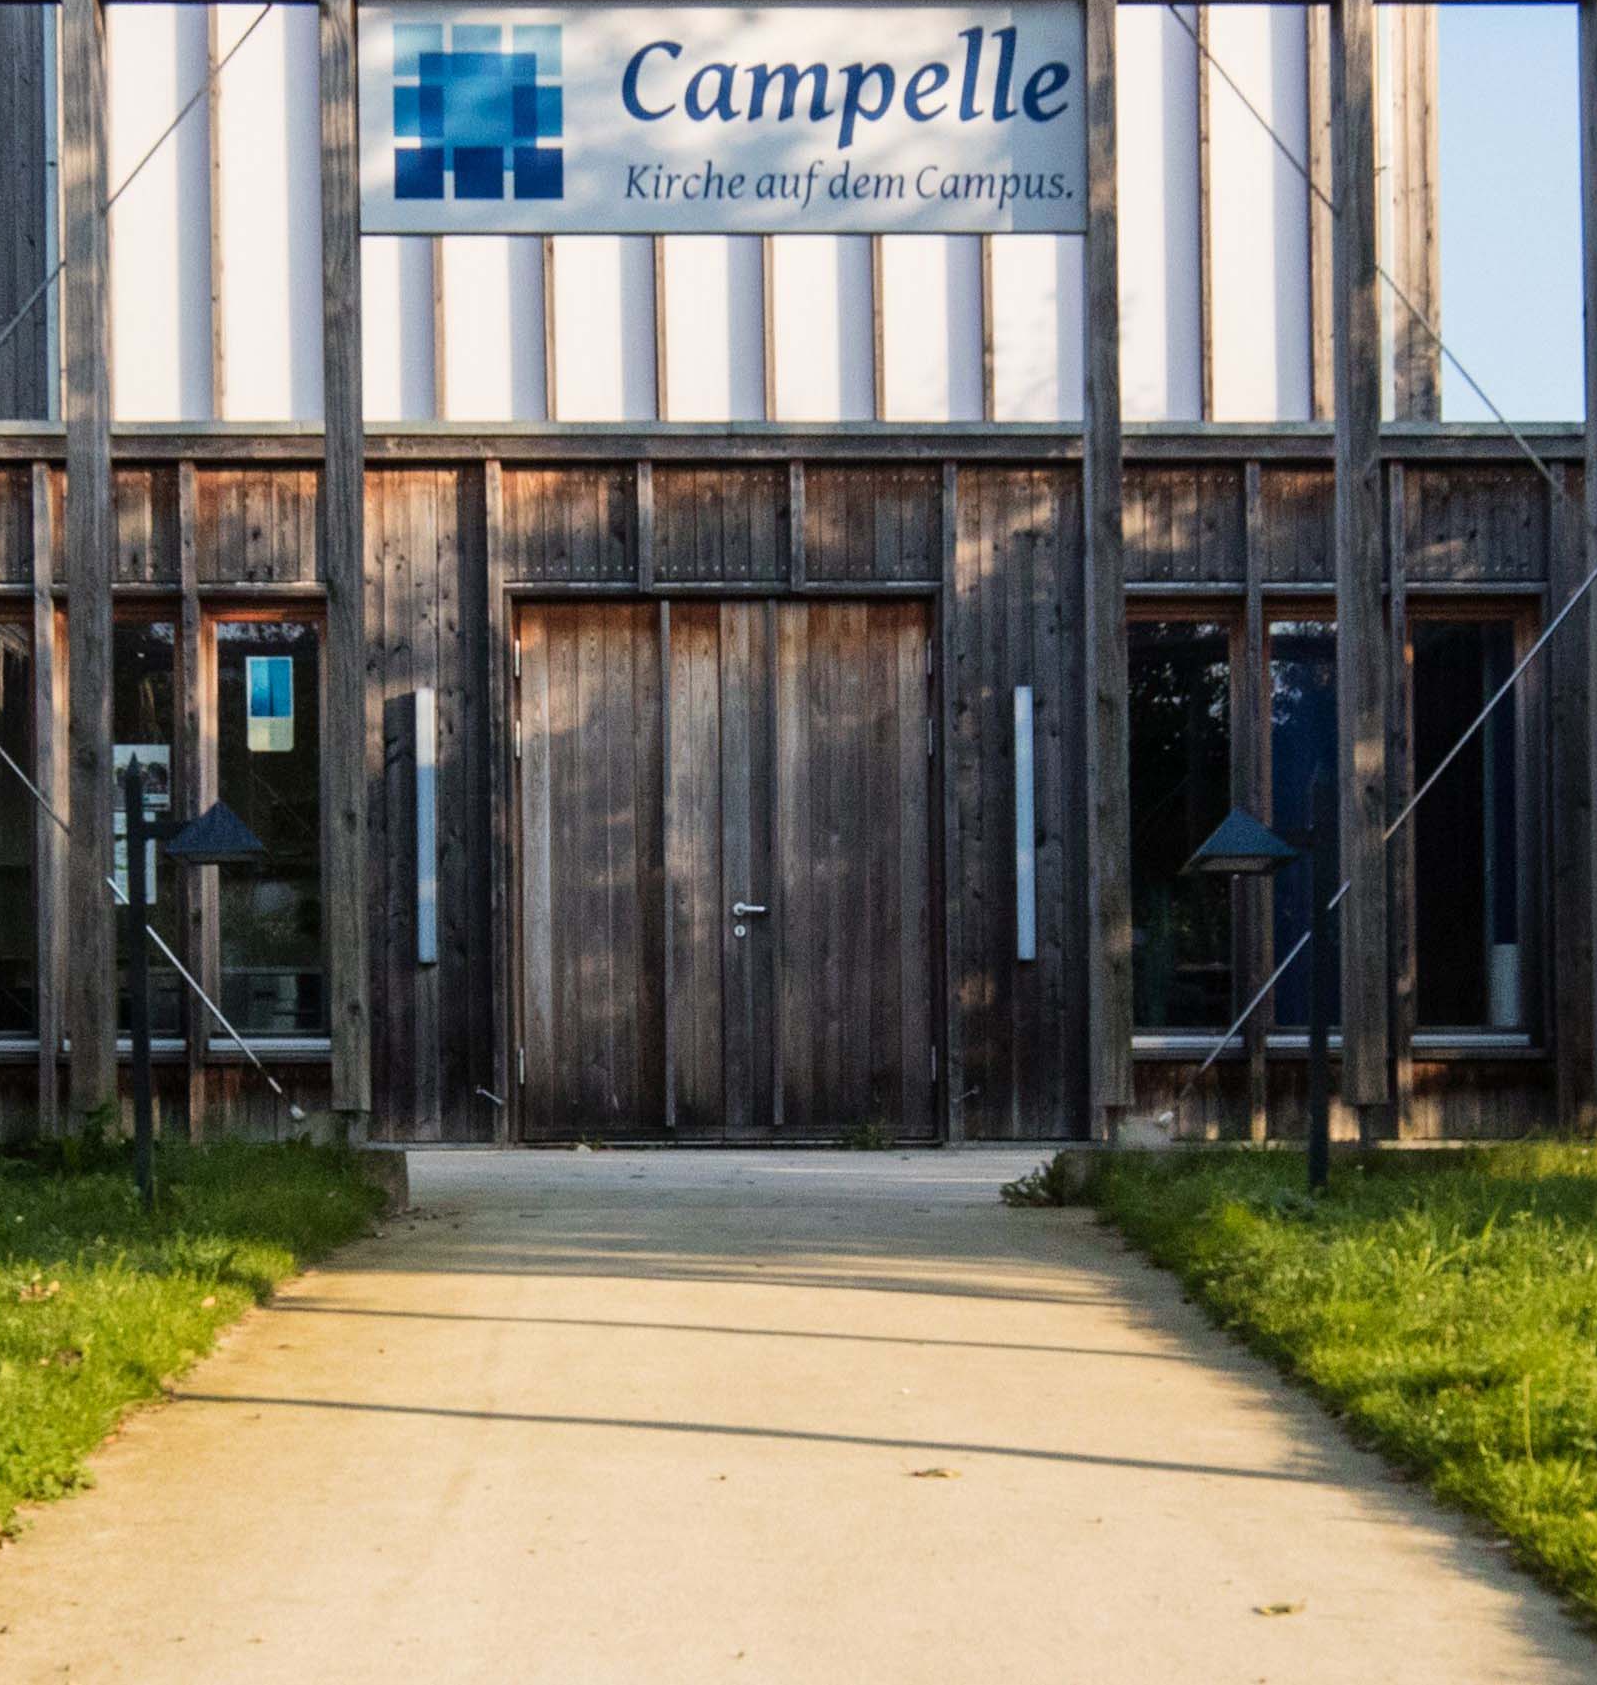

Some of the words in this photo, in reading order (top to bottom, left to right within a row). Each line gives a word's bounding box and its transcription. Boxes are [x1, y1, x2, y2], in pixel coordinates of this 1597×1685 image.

[621, 25, 1071, 150] Campelle
[625, 160, 746, 200] Kirche
[755, 160, 824, 210] auf
[828, 160, 906, 200] dem
[915, 165, 1075, 211] Campus.
